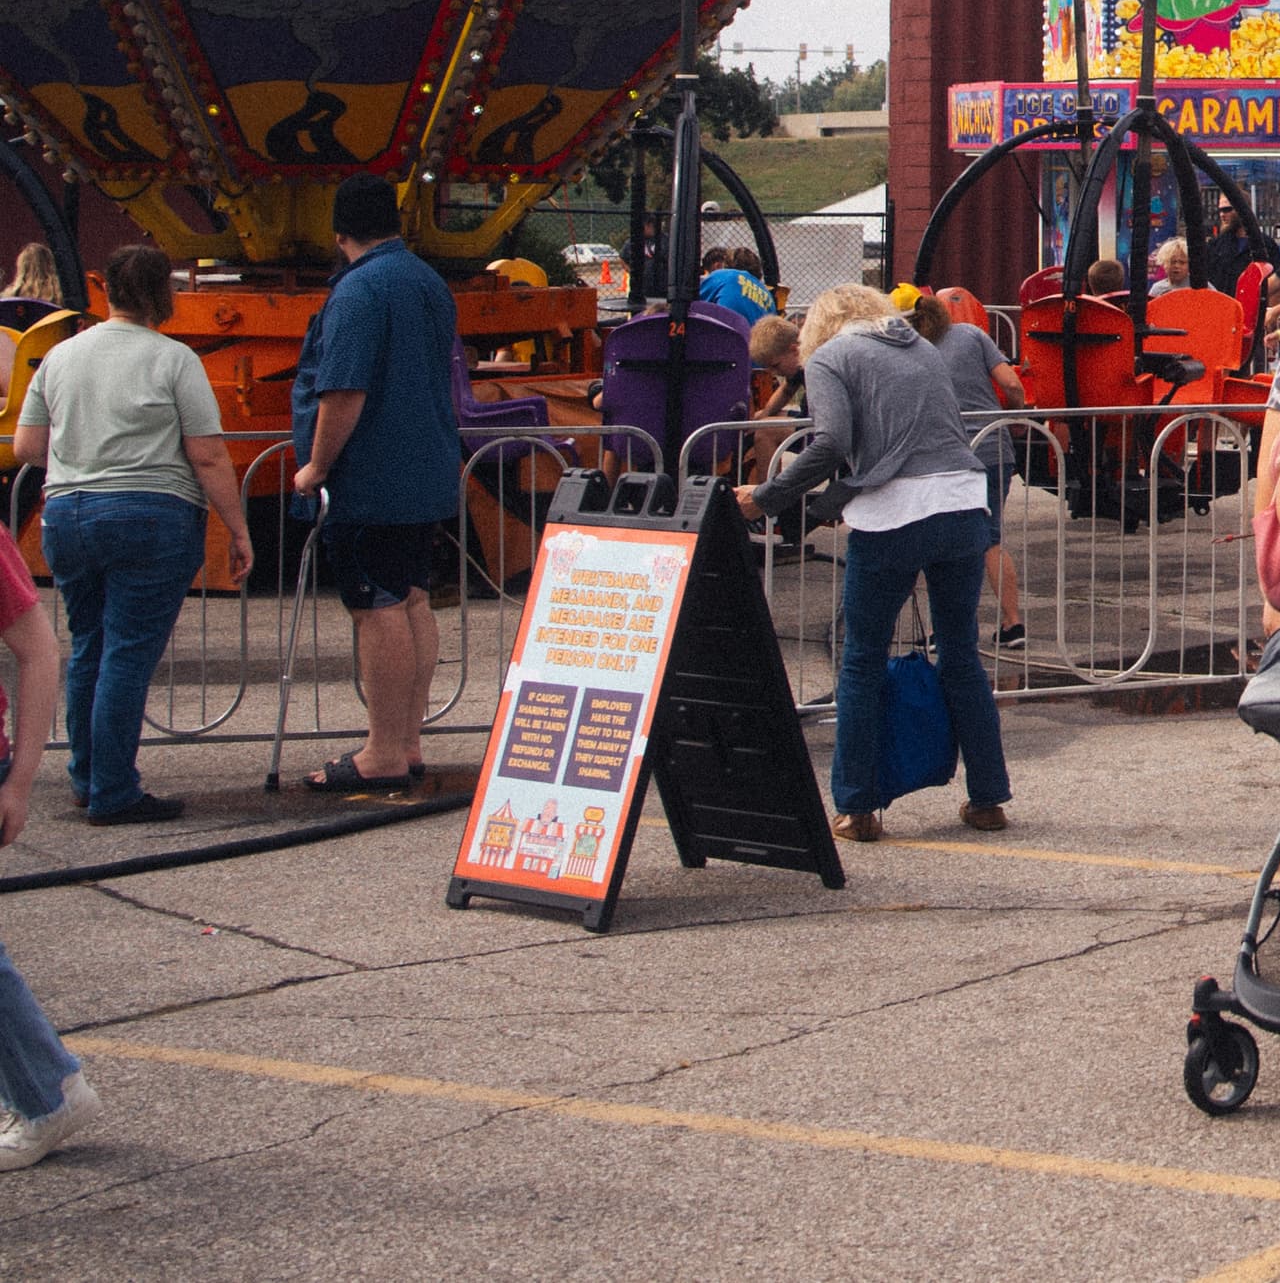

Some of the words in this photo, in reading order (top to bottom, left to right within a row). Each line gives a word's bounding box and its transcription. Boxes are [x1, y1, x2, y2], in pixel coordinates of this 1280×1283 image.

[1016, 91, 1053, 115] ICE
[1061, 92, 1119, 115] CLD
[956, 93, 993, 135] NACHOS
[571, 569, 651, 592] WRISTBANDS,
[550, 587, 630, 610] MEGABANDS,
[632, 594, 664, 612] AND
[549, 607, 626, 629] MEGAPASSES
[628, 614, 655, 632] ARE
[535, 626, 599, 647] INTENDED
[601, 632, 628, 650] FOR
[630, 636, 658, 653] ONE
[545, 648, 596, 667] PERSON
[597, 653, 638, 672] ONLY!
[528, 692, 535, 701] IF
[536, 693, 566, 704] CAUGHT
[518, 705, 549, 716] SHARING
[550, 708, 569, 718] THEY
[591, 699, 632, 712] EMPLOYEES
[514, 718, 531, 727] WILL
[532, 719, 542, 729] BE
[543, 721, 566, 732] TAKEN
[590, 713, 611, 724] HAVE
[612, 715, 627, 725] THE
[521, 732, 540, 742] WITH
[541, 733, 552, 744] NO
[579, 725, 601, 736] RIGHT
[602, 728, 612, 738] TO
[613, 729, 632, 740] TAKE
[511, 744, 543, 757] REFUNDS
[544, 748, 555, 758] OR
[577, 739, 597, 749] THEM
[597, 741, 619, 752] AWAY
[619, 744, 628, 753] IF
[575, 753, 593, 763] THEY
[594, 755, 623, 767] SUSPECT
